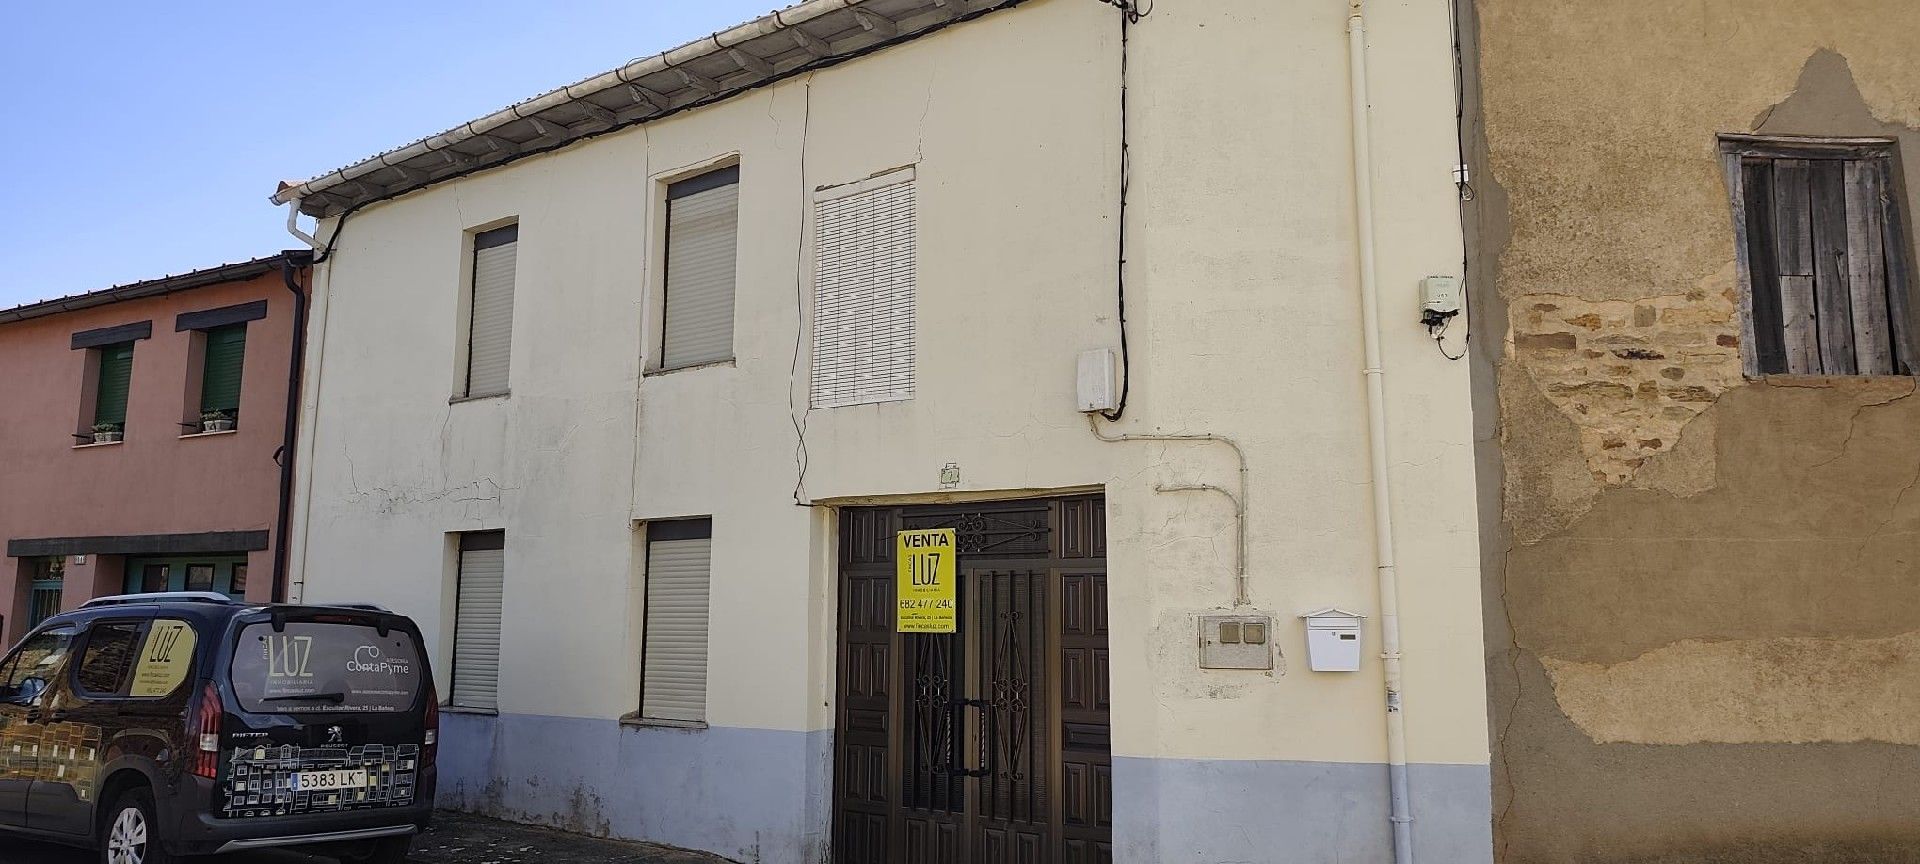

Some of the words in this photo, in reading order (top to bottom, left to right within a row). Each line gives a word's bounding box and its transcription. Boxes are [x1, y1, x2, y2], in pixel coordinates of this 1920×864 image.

[903, 533, 949, 548] VENTA
[912, 553, 940, 586] LUZ
[150, 625, 184, 662] LUZ
[268, 635, 313, 677] LUZ
[346, 660, 409, 675] ContaPyme
[301, 773, 336, 788] 5383
